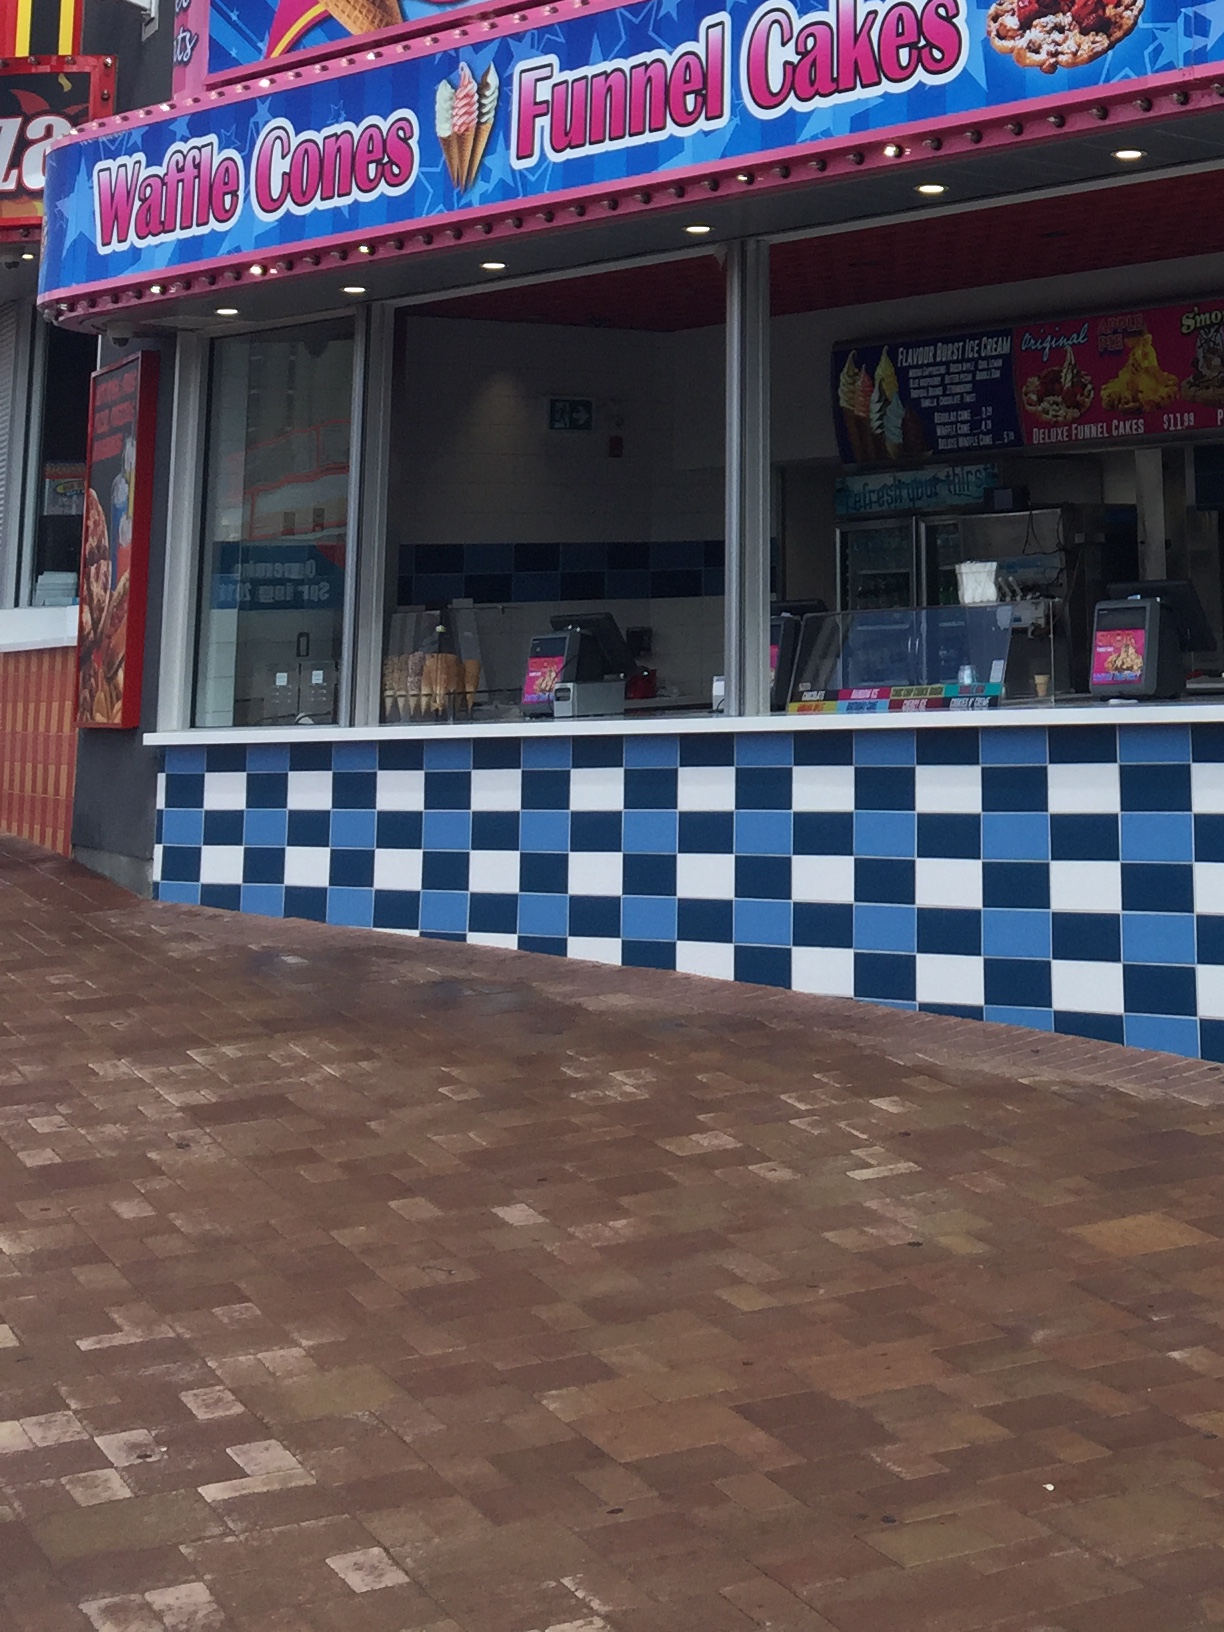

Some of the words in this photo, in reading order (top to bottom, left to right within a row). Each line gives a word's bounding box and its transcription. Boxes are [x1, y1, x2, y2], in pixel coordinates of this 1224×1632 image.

[515, 19, 726, 161] Funnel
[97, 141, 241, 247] Waffle
[255, 119, 414, 215] Cones
[964, 338, 980, 359] ICE
[980, 335, 1011, 357] CREAM
[1021, 322, 1089, 363] Original
[1032, 426, 1069, 444] DELUXE
[1071, 423, 1110, 441] FUNNEL
[1112, 419, 1145, 436] CAKES
